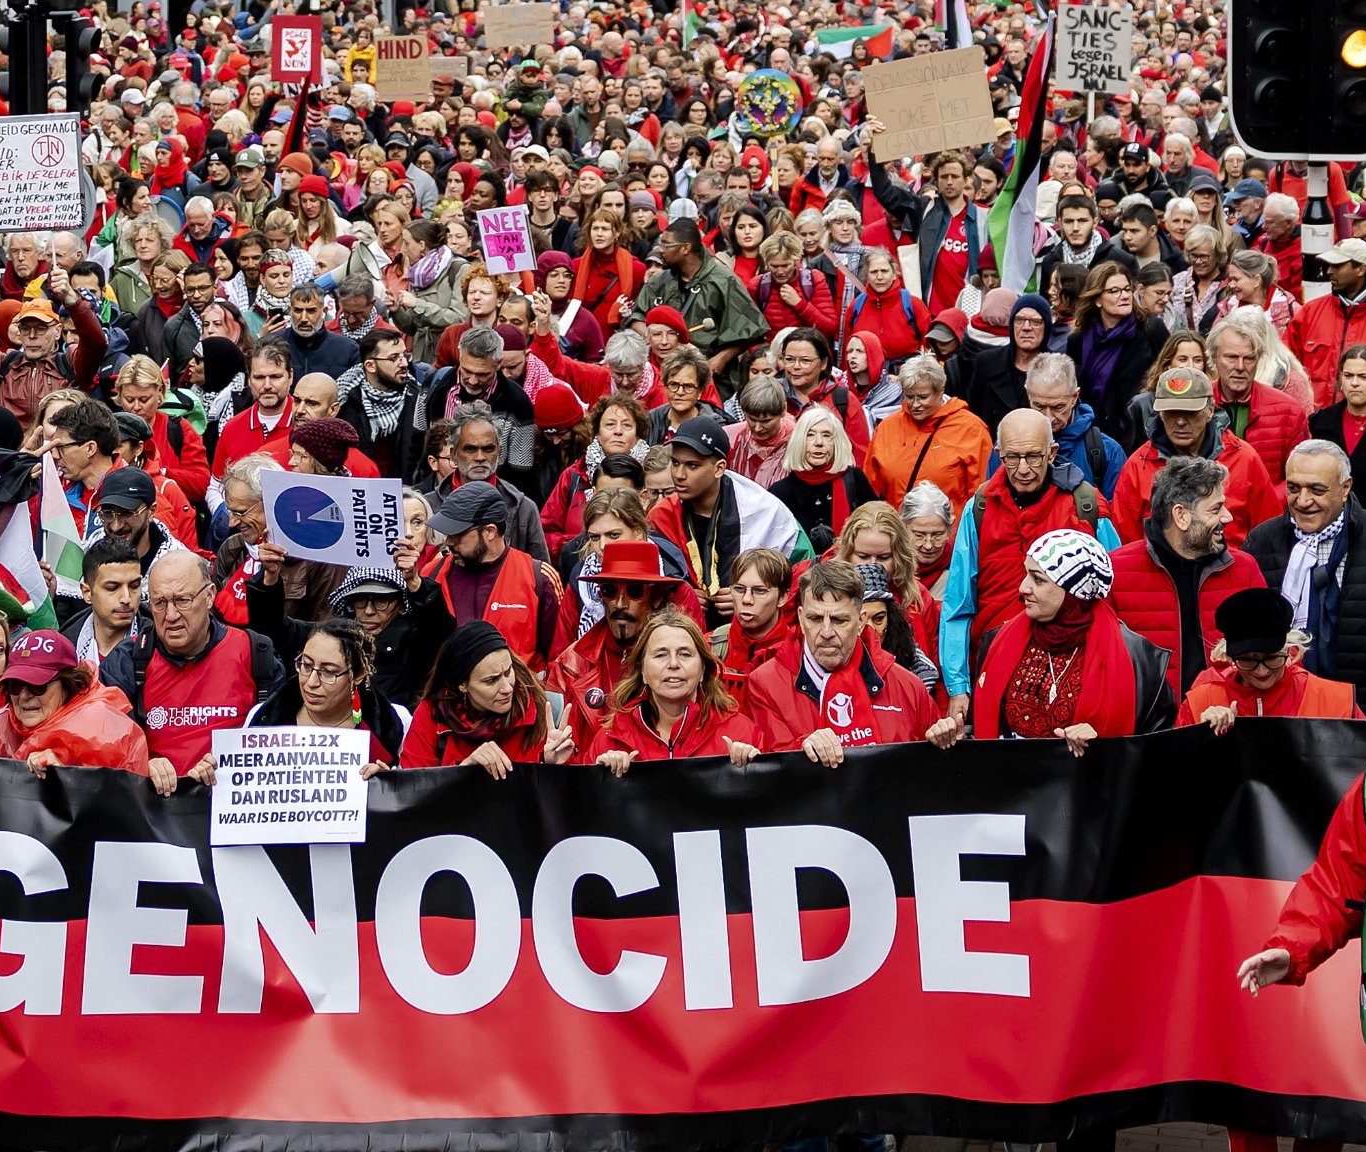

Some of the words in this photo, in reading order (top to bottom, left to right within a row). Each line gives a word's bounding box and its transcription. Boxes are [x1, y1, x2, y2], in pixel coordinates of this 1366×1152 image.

[1065, 8, 1129, 31] SANC-
[1067, 31, 1117, 51] TIES
[377, 39, 423, 60] HIND
[1071, 48, 1113, 63] tegen
[284, 59, 307, 69] NOW
[939, 97, 971, 119] MET
[8, 182, 37, 193] LAAT
[53, 181, 69, 190] ME
[14, 207, 24, 215] ER
[25, 205, 53, 214] VREDE
[481, 211, 526, 234] NEE
[496, 234, 519, 244] TAN
[498, 245, 522, 254] YAH
[352, 489, 370, 558] PATIENTS
[369, 513, 383, 535] ON
[383, 493, 399, 556] ATTACKS
[169, 716, 208, 726] FORUM
[242, 734, 306, 748] ISRAEL:
[310, 734, 340, 748] 12X
[851, 727, 872, 741] the
[219, 753, 263, 768] MEER
[265, 752, 361, 767] AANVALLEN
[232, 772, 255, 786] OP
[259, 766, 348, 786] PATIËNTEN
[232, 791, 265, 805] DAN
[269, 788, 347, 804] RUSLAND
[218, 813, 255, 824] WAAR
[257, 812, 268, 824] IS
[271, 812, 287, 823] DE
[288, 810, 358, 823] BOYCOTT?!
